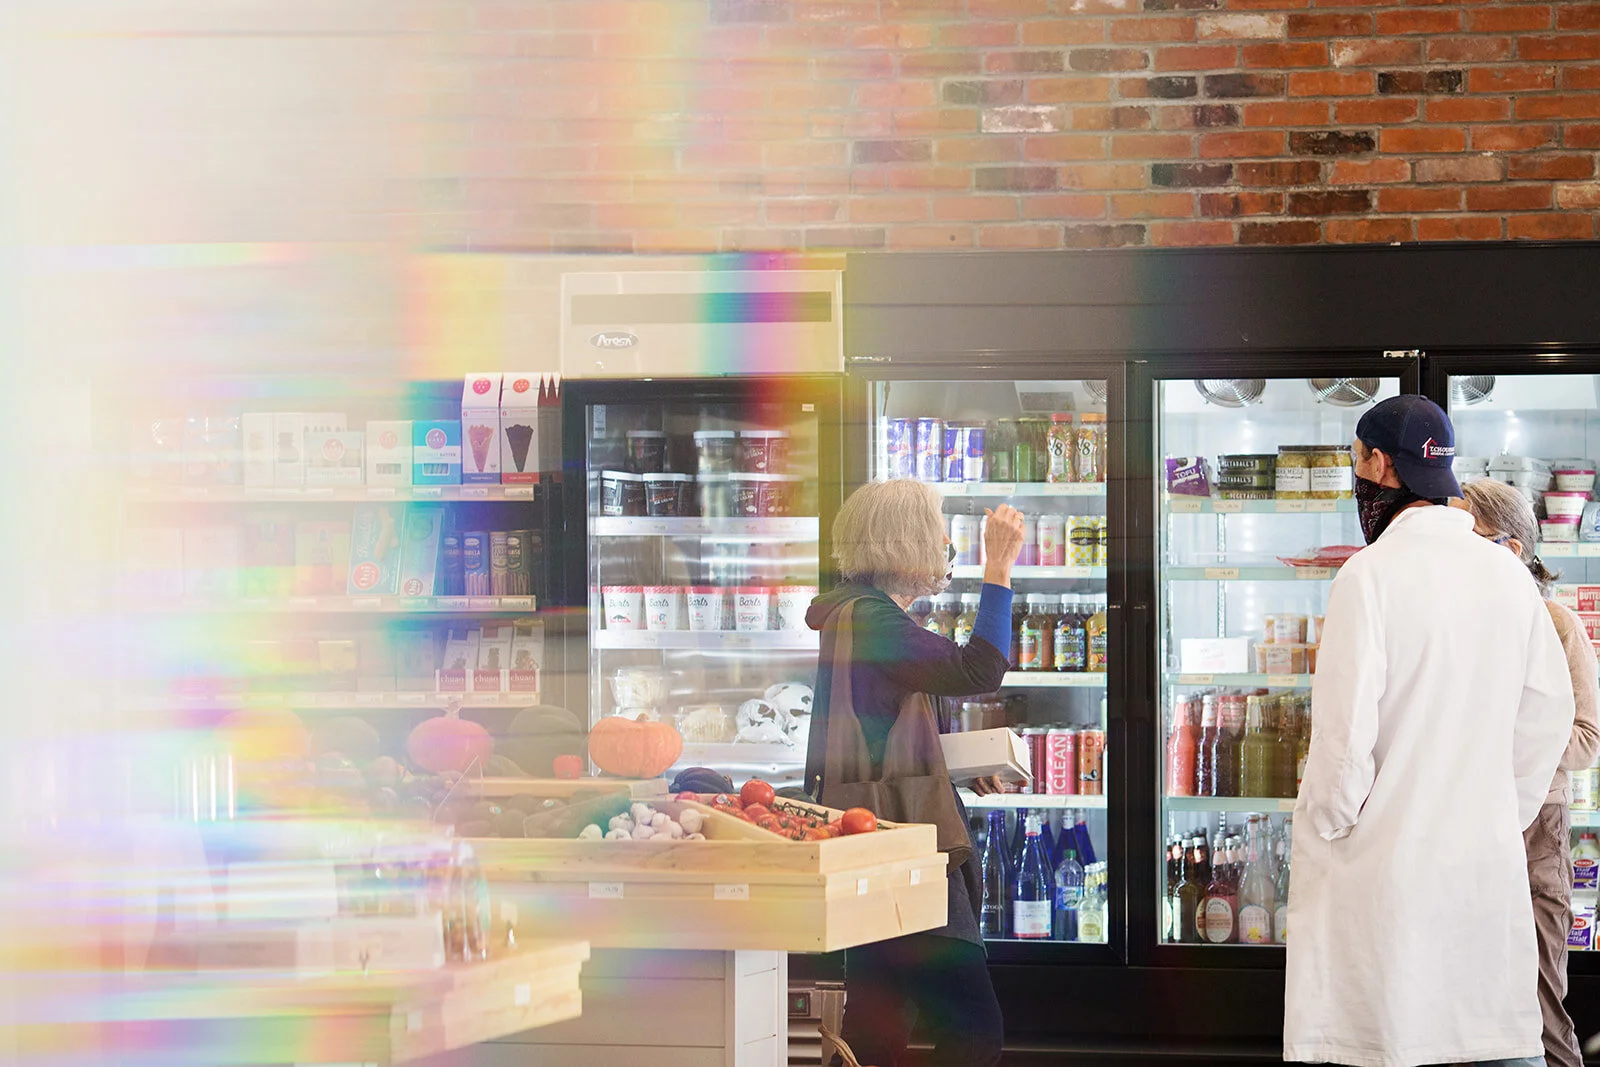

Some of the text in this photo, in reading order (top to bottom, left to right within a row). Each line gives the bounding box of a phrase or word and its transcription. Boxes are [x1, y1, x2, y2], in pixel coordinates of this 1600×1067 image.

[1174, 468, 1196, 479] TOFU
[687, 596, 709, 607] Barts
[739, 596, 762, 607] Barts
[1583, 618, 1600, 627] UTTE
[441, 674, 464, 683] chuao
[474, 674, 498, 683] chuao
[510, 673, 534, 681] chuao
[1053, 735, 1067, 791] CLEAN
